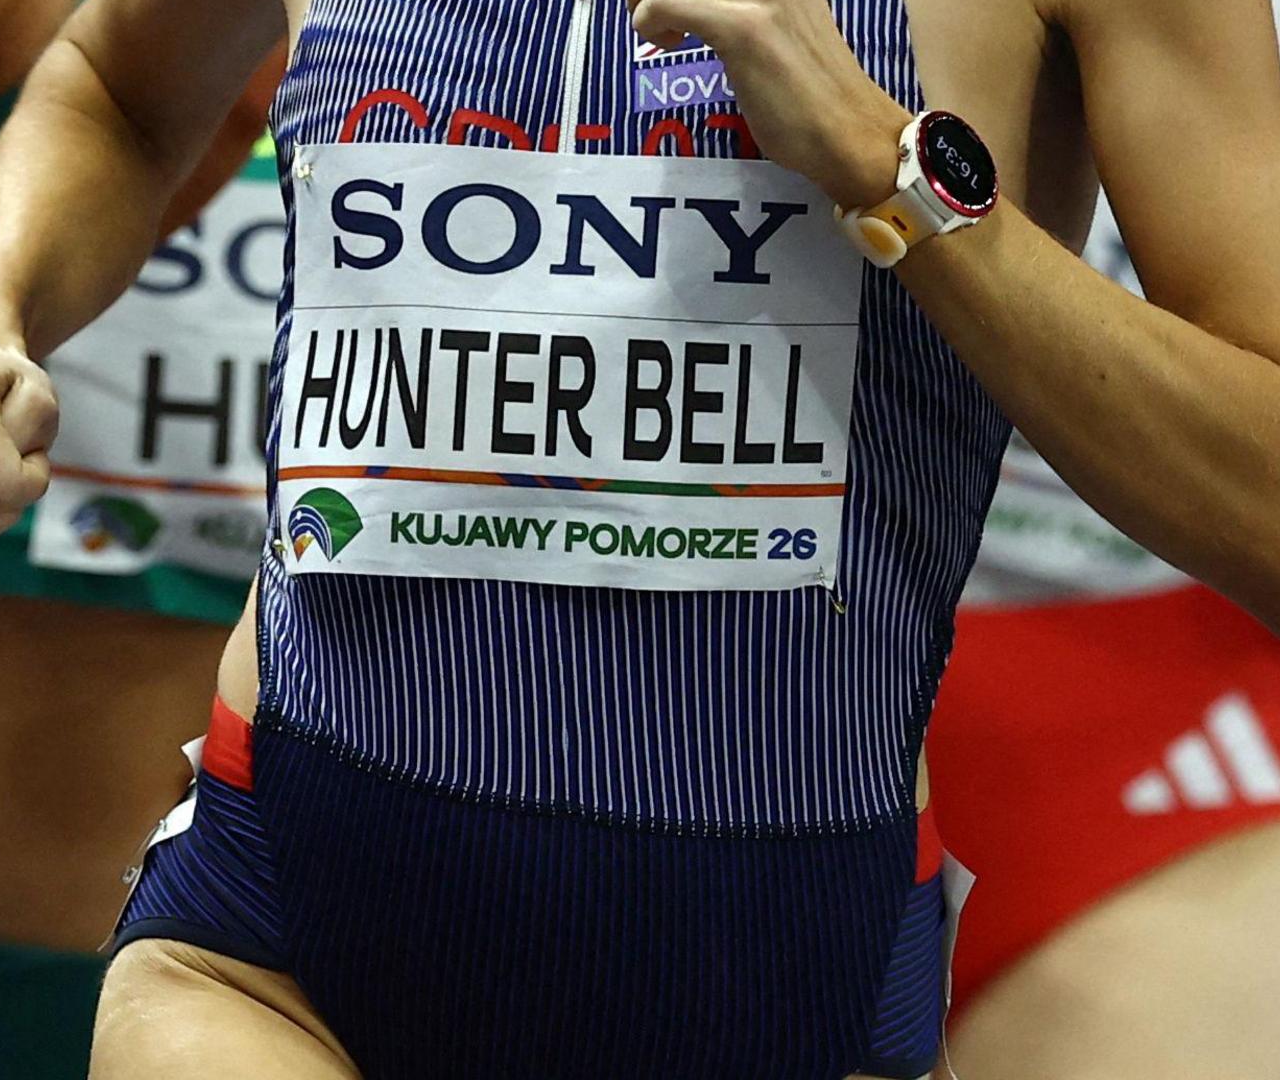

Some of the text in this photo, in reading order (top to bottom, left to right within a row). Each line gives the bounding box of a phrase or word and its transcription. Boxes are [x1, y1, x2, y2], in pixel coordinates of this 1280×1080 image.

[936, 136, 979, 190] 16:34
[330, 178, 808, 285] SONY
[139, 352, 272, 467] H
[293, 327, 824, 465] HUNTER BELL
[389, 512, 817, 560] KUJAWY POMORZE 26
